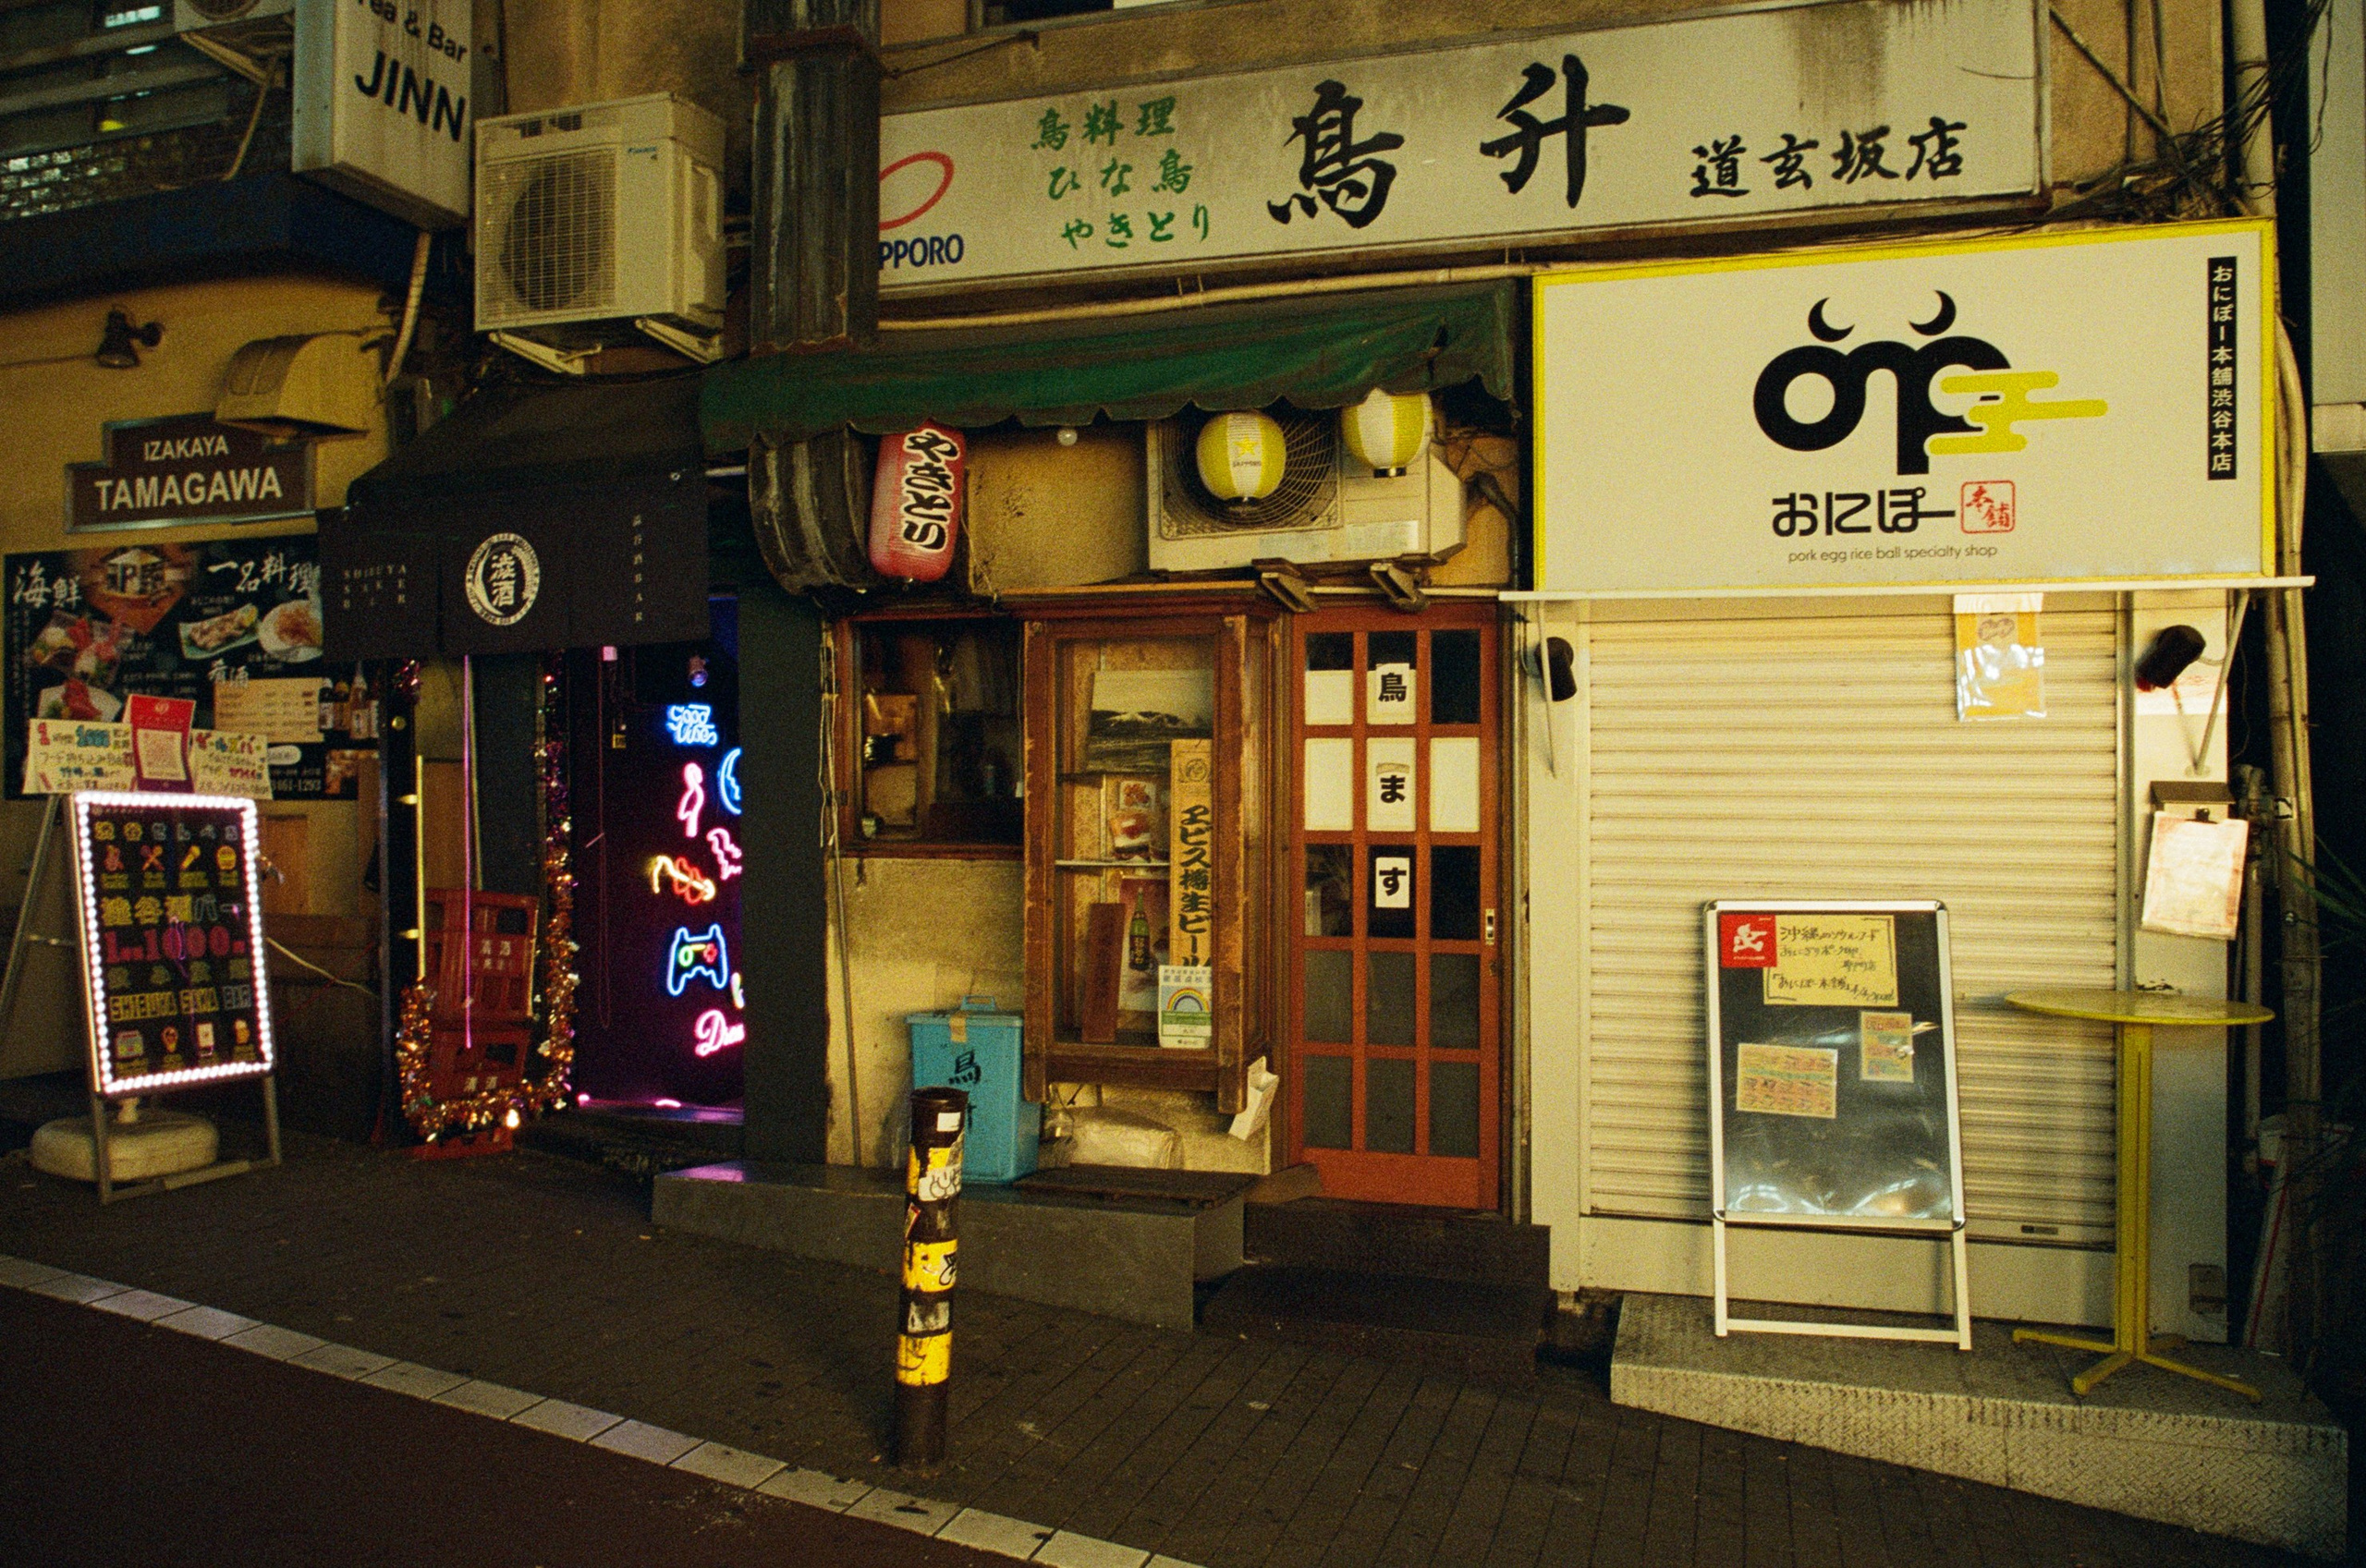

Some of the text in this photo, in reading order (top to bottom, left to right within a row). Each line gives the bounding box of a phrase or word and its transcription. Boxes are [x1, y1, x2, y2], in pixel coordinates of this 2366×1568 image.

[357, 0, 468, 62] ea & Bar
[355, 50, 466, 142] JINN
[1031, 95, 1177, 151] 鳥料理
[1267, 54, 1630, 228] 鳥升
[1048, 149, 1193, 201] ひな鳥
[1689, 116, 1968, 198] 道玄坂店
[878, 233, 964, 270] PPORO
[1061, 202, 1209, 250] やきとり
[143, 434, 230, 461] IZAKAYA
[94, 466, 284, 511] TAMAGAWA
[1772, 487, 1956, 538] おにぽー
[1788, 544, 1998, 564] pork egg rice ball specialty shop
[668, 703, 712, 724] Good
